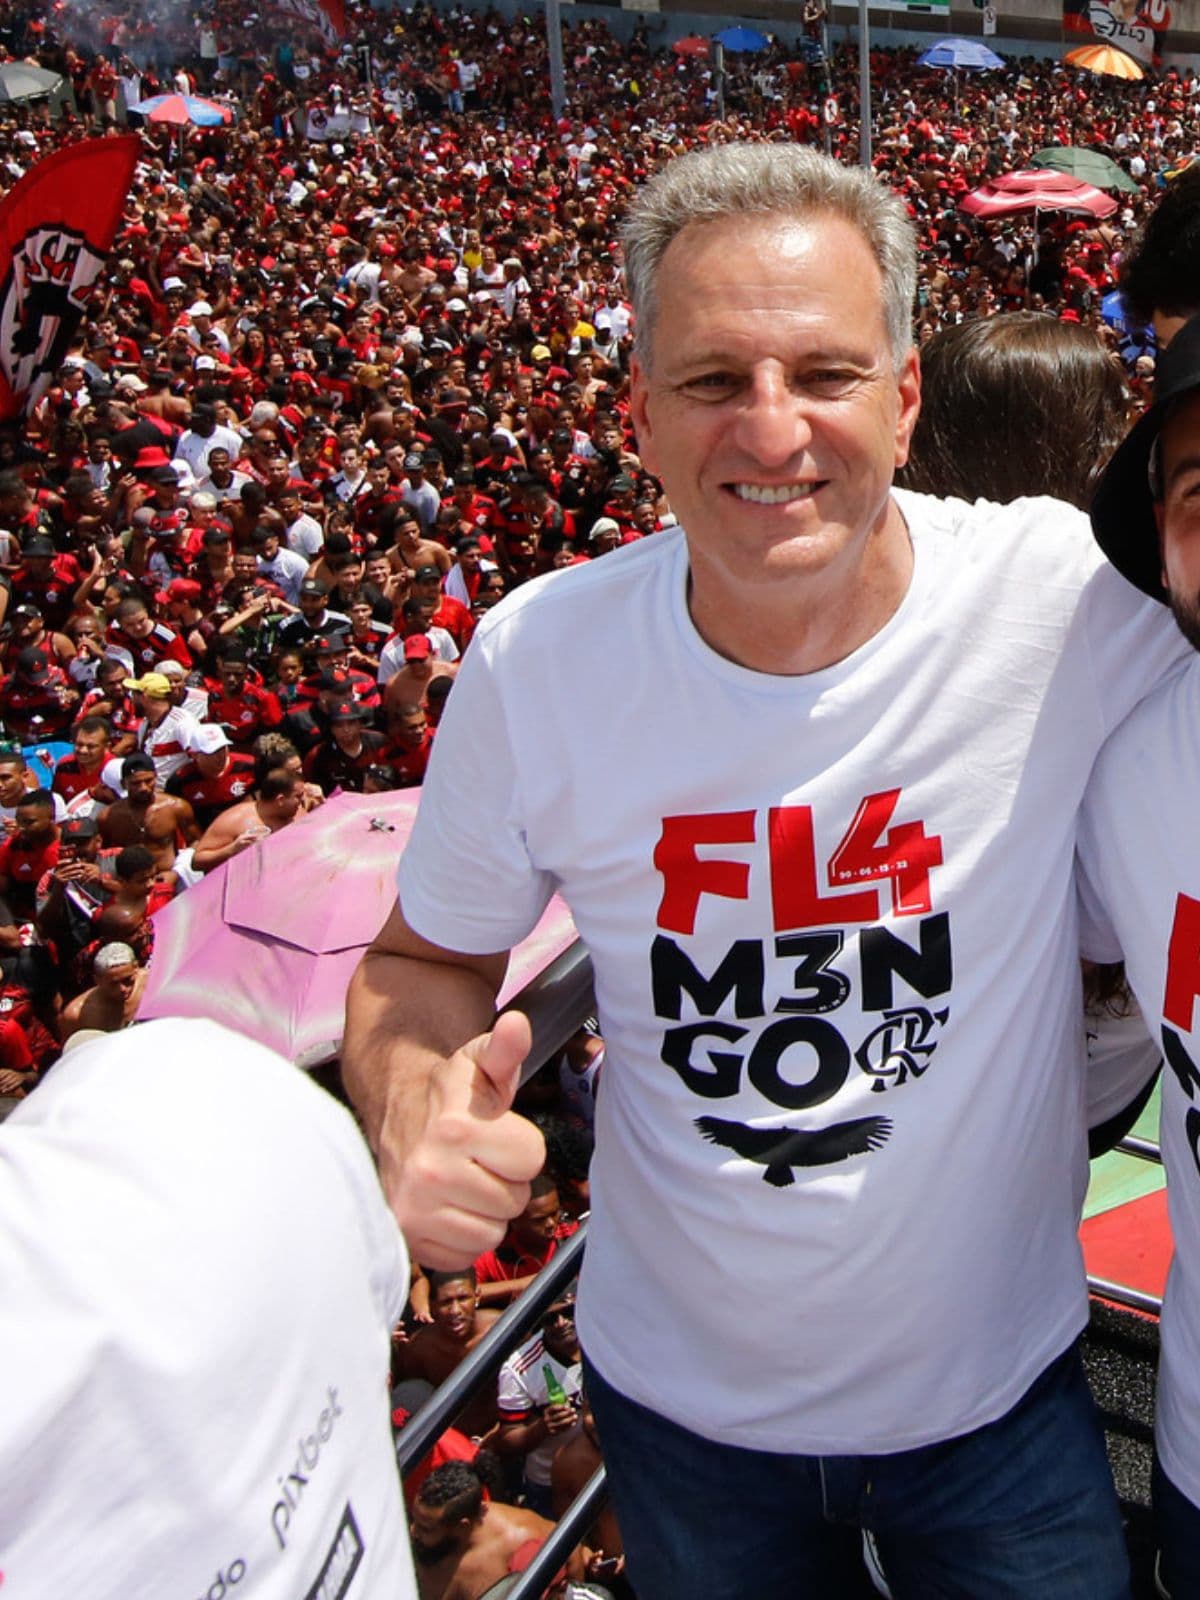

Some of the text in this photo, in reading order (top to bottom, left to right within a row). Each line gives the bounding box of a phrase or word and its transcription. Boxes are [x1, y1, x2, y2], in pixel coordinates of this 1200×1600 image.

[653, 787, 944, 935] FL4
[650, 911, 953, 1021] M3N
[660, 1015, 852, 1110] GO
[271, 1385, 342, 1550] pixbet
